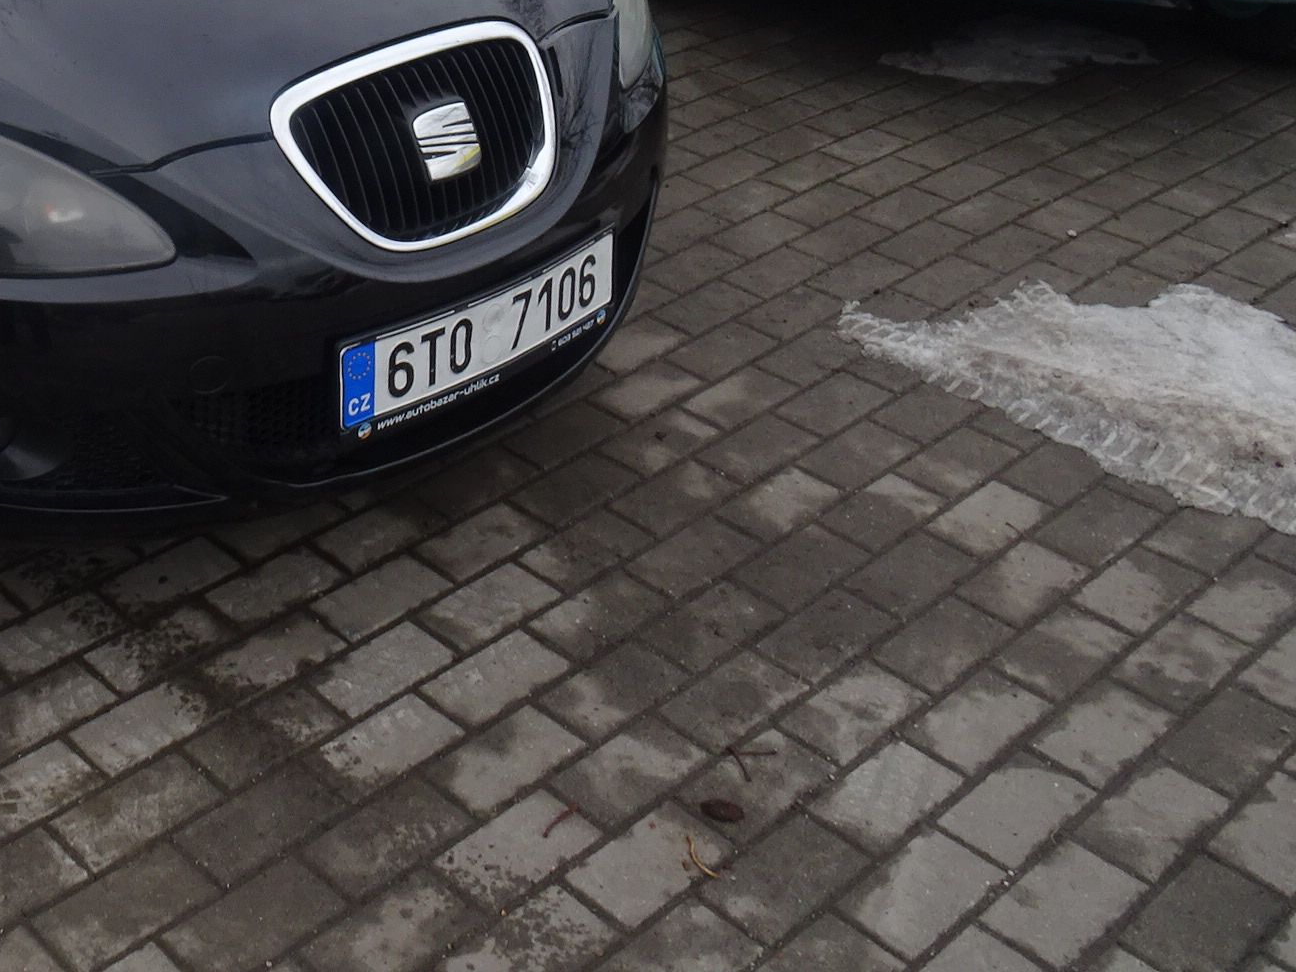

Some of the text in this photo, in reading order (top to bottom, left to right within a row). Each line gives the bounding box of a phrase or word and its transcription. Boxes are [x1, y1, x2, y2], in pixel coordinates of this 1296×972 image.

[386, 253, 597, 399] 6T0 7106
[347, 391, 372, 417] CZ
[376, 373, 501, 431] www.autobazar-uhlik.cz
